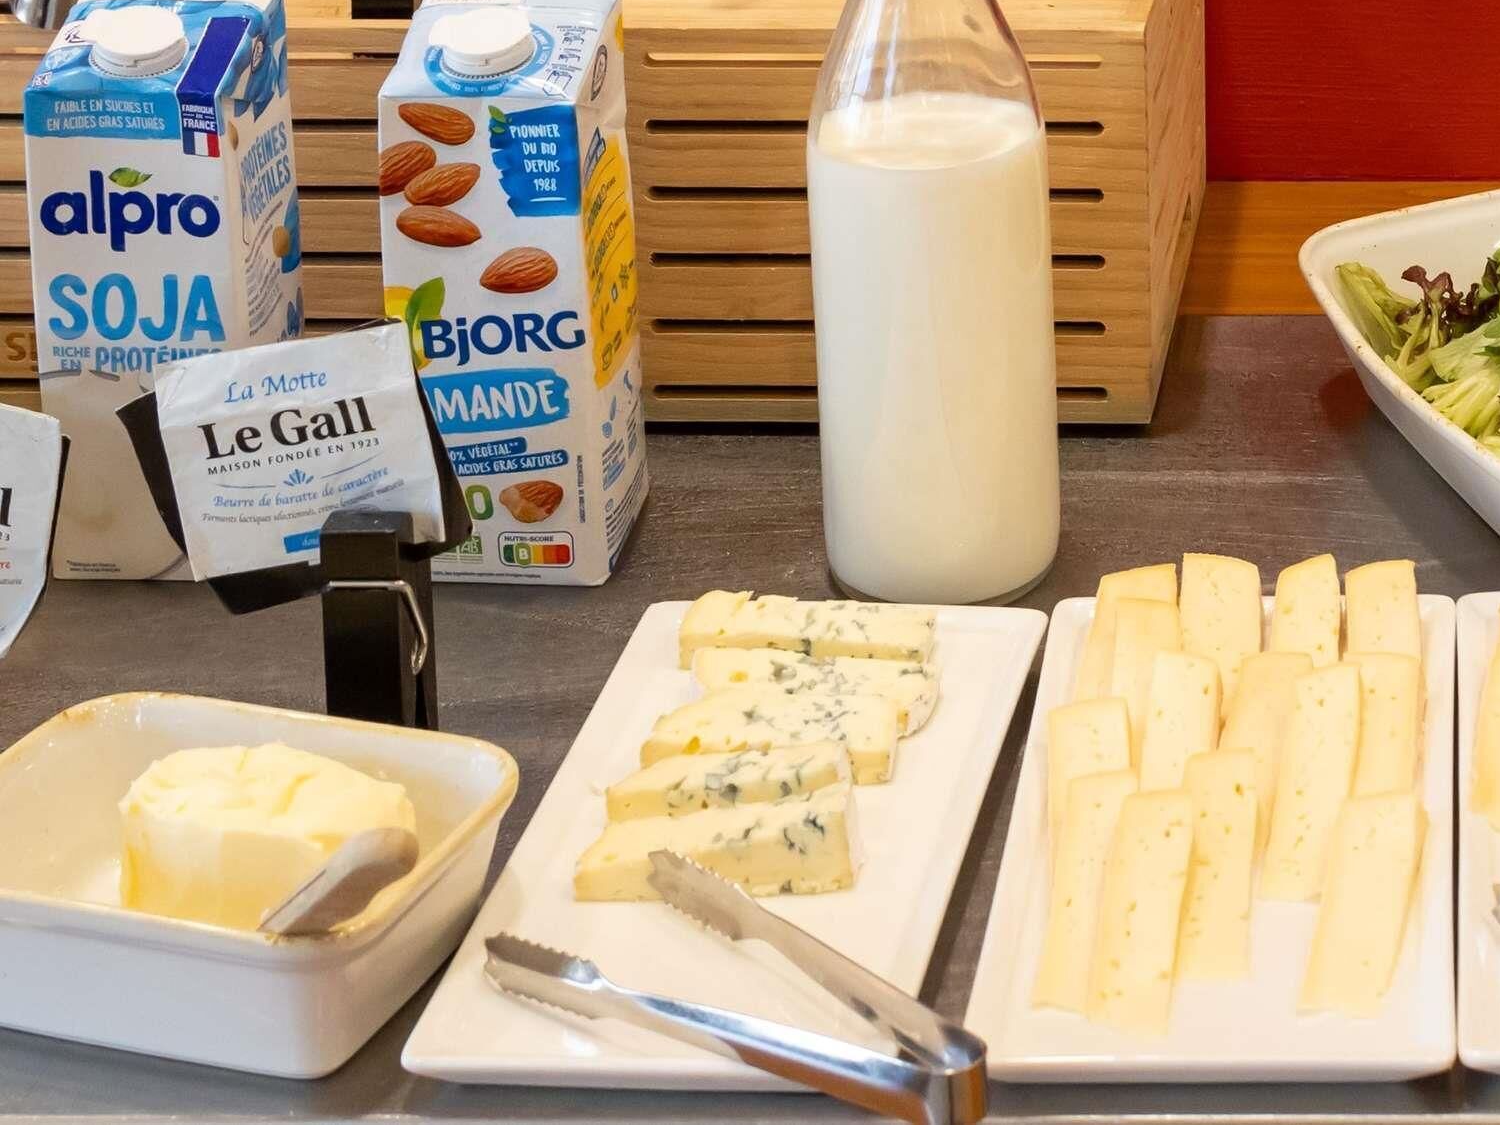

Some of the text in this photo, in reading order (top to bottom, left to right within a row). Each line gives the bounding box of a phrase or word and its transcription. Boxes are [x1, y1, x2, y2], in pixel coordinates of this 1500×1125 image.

[54, 99, 155, 115] FAIBLE EN SUCRES ET
[63, 115, 97, 130] ACIDES
[99, 115, 124, 129] GRAS
[182, 118, 216, 132] FRANCE
[509, 124, 561, 139] PIONNIER
[523, 143, 538, 156] DU
[523, 159, 561, 174] DEPUIS
[533, 177, 557, 192] 1988
[39, 170, 221, 252] alpro
[48, 273, 226, 343] SOJA
[52, 346, 91, 358] RICHE
[60, 359, 82, 371] EN
[224, 370, 328, 404] La Motte
[425, 379, 560, 423] MANDE
[198, 395, 377, 460] Le Gall
[207, 437, 380, 475] MAISON FONDÉE EN 1923
[458, 461, 491, 475] ACIDES
[493, 460, 518, 473] GRAS
[213, 495, 255, 508] Beurre
[258, 493, 272, 507] de
[275, 488, 318, 506] baratte
[322, 483, 335, 497] de
[518, 548, 529, 560] B
